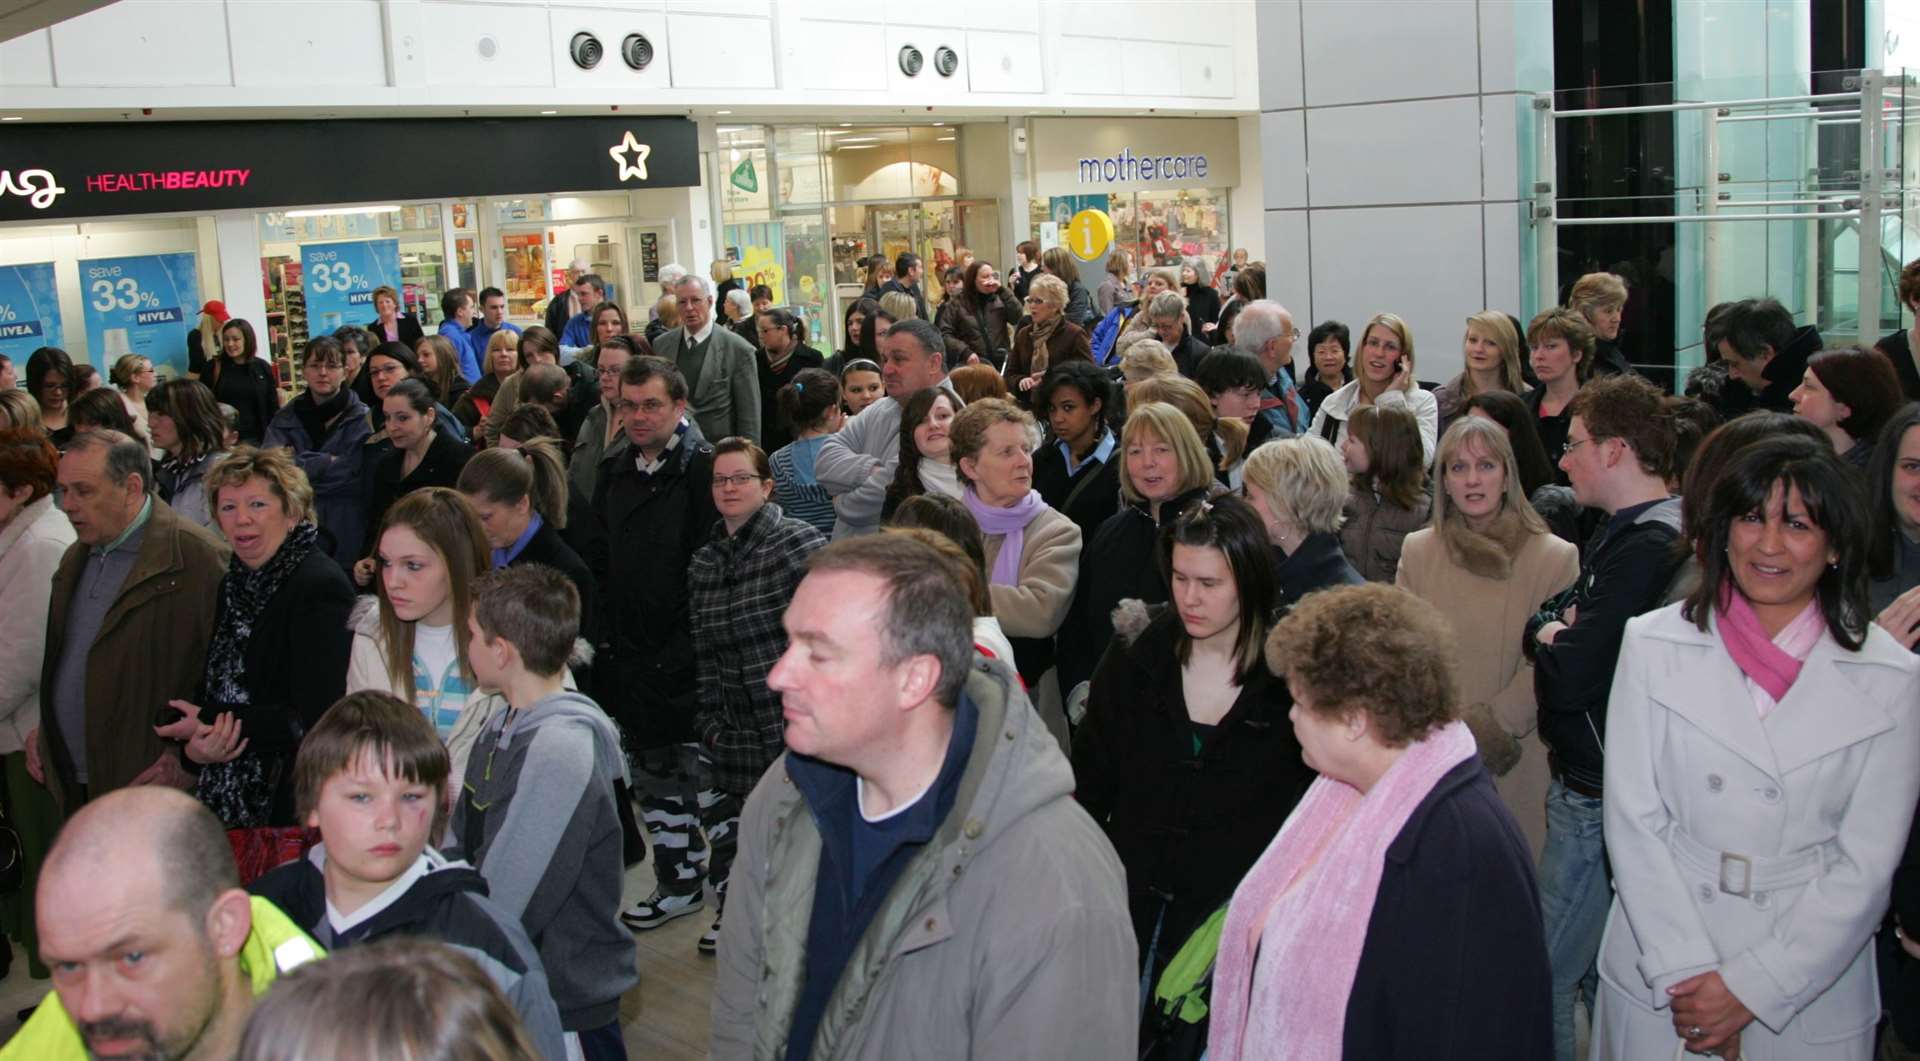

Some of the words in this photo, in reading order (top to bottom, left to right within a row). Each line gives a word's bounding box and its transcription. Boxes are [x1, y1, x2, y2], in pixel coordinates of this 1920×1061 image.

[1079, 148, 1208, 183] mothercare
[86, 169, 250, 193] HEALTHBEAUTY
[1082, 217, 1094, 255] i
[309, 251, 337, 263] save
[88, 265, 122, 280] save
[311, 262, 369, 293] 33%
[91, 277, 161, 313] 33%
[350, 293, 374, 304] NIVE
[138, 310, 176, 324] NIVEA
